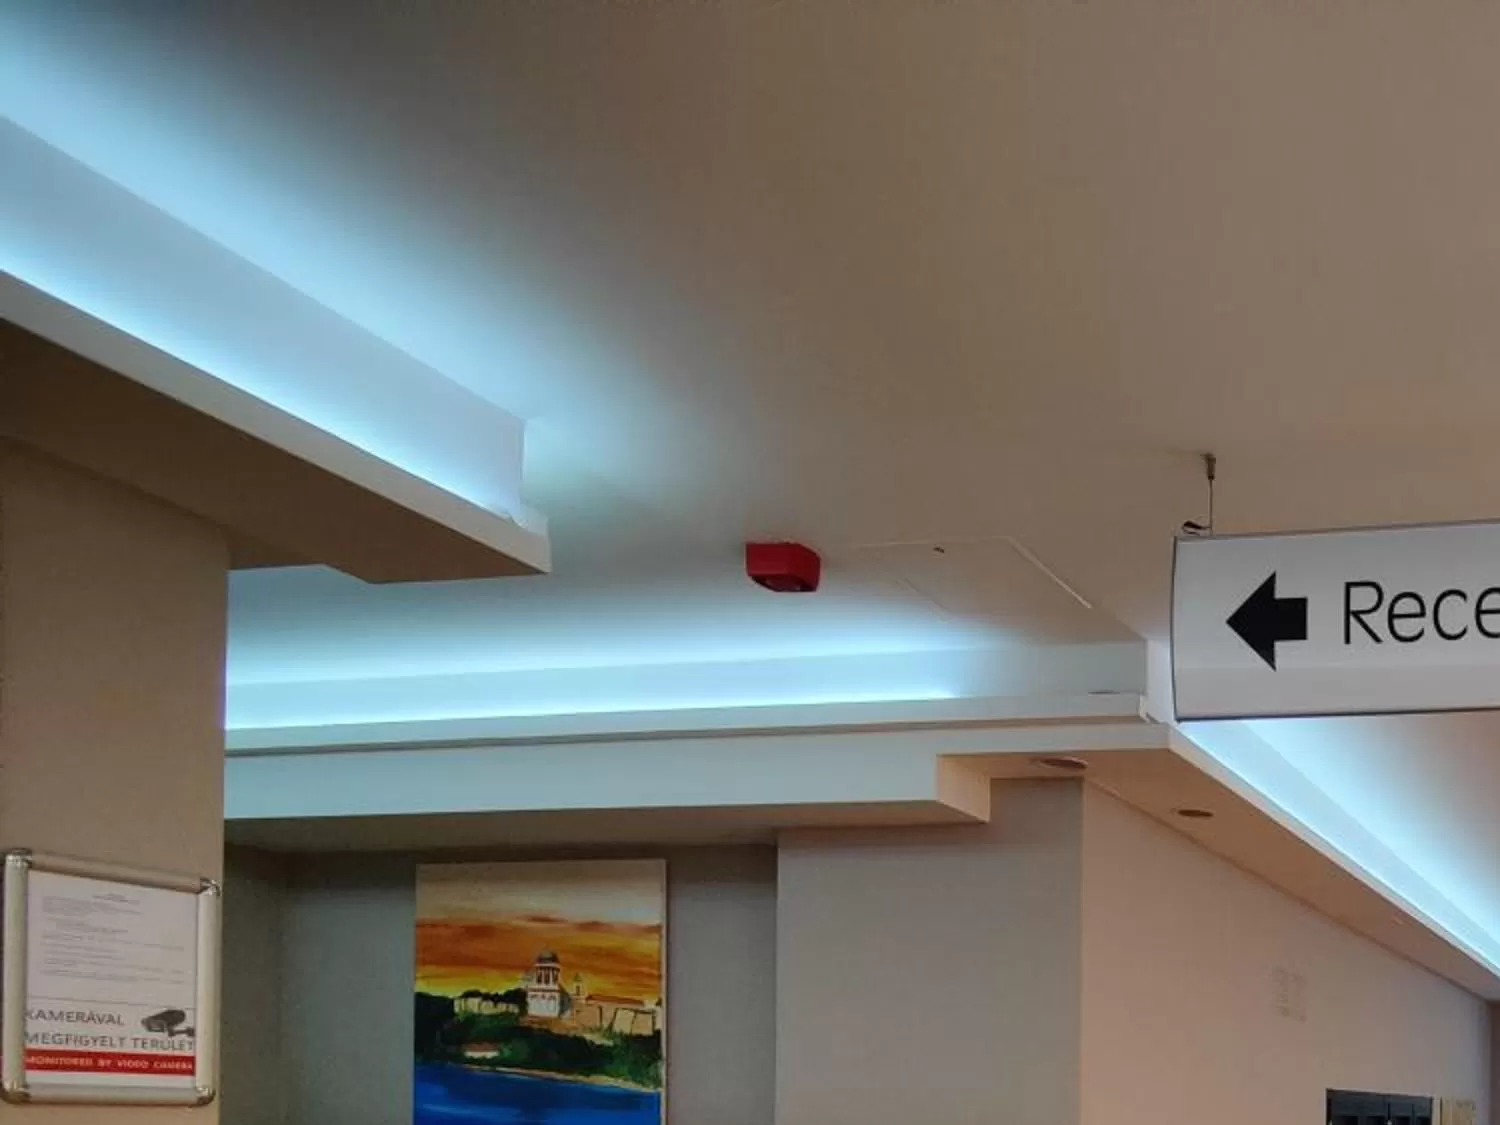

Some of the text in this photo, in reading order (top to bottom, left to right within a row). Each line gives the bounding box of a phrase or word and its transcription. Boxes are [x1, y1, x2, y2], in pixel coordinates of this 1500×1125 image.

[25, 1031, 125, 1049] MEGFIGYELT
[99, 1058, 112, 1067] BY
[117, 1058, 149, 1069] VIDEO
